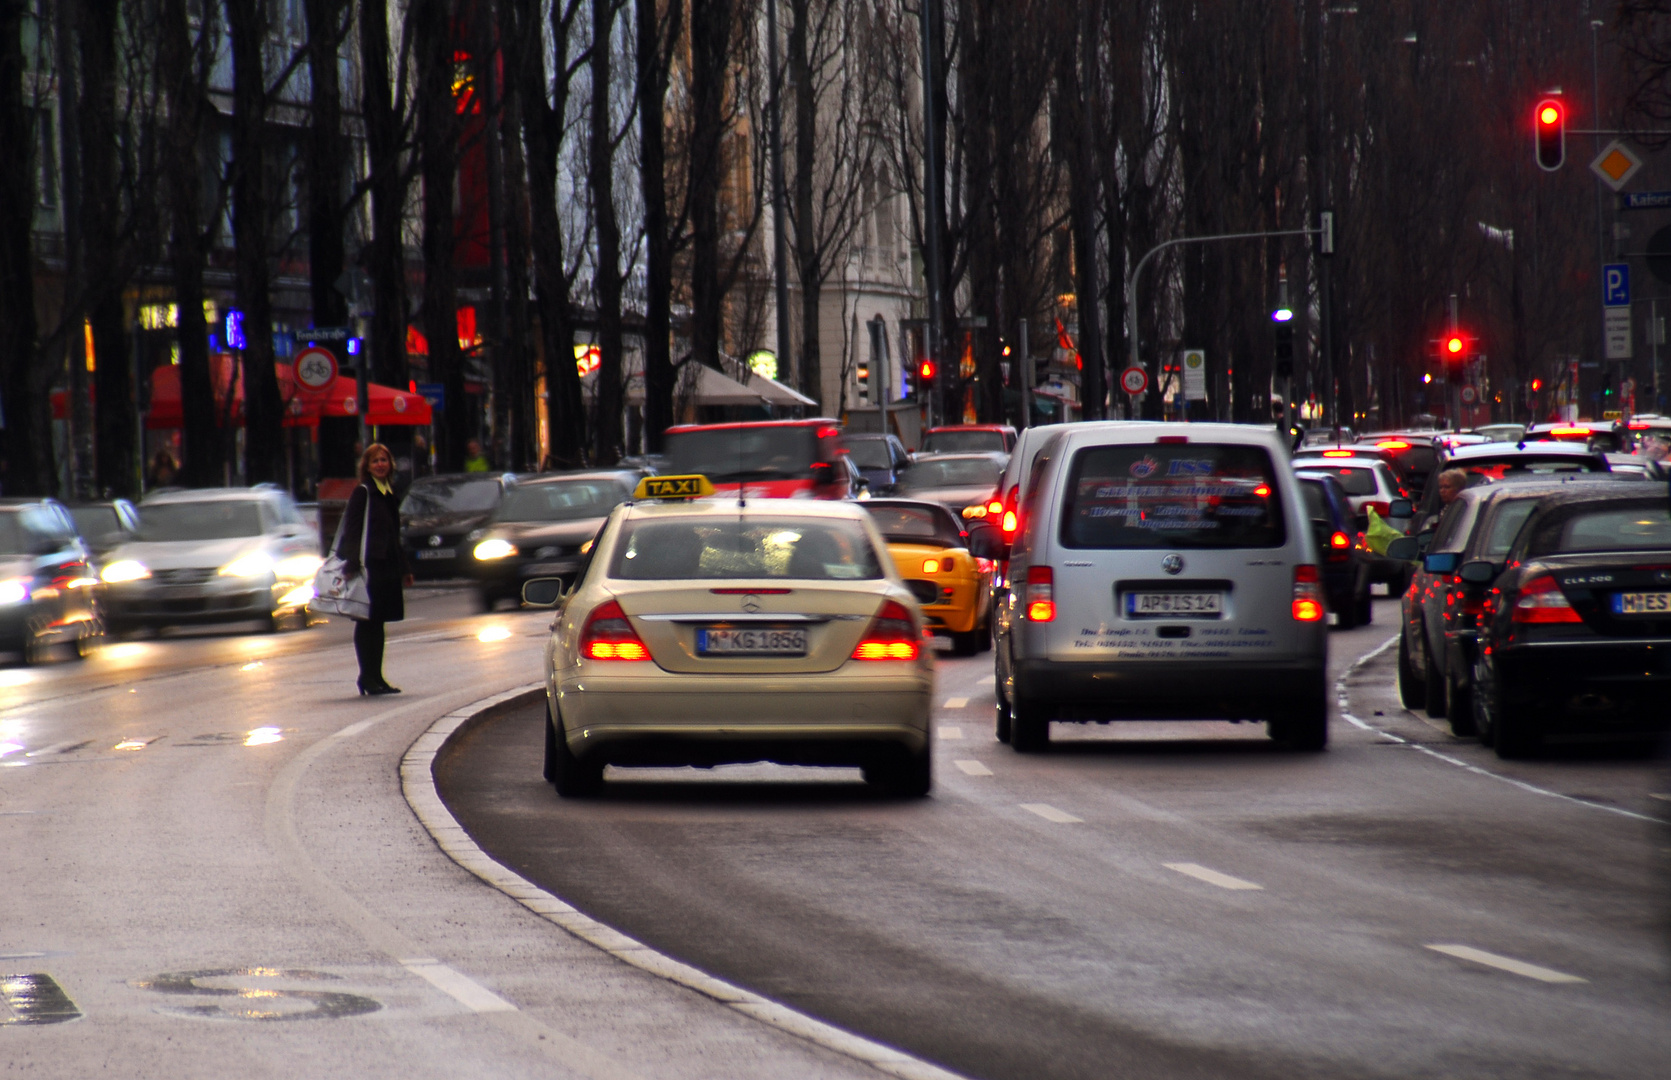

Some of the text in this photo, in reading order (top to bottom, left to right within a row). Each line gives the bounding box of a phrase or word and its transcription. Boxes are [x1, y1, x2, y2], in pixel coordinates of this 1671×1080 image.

[1607, 269, 1621, 302] P
[648, 480, 697, 494] TAXI
[1141, 595, 1160, 610] AP
[1195, 595, 1215, 610] 14
[707, 631, 805, 649] M KG 1856
